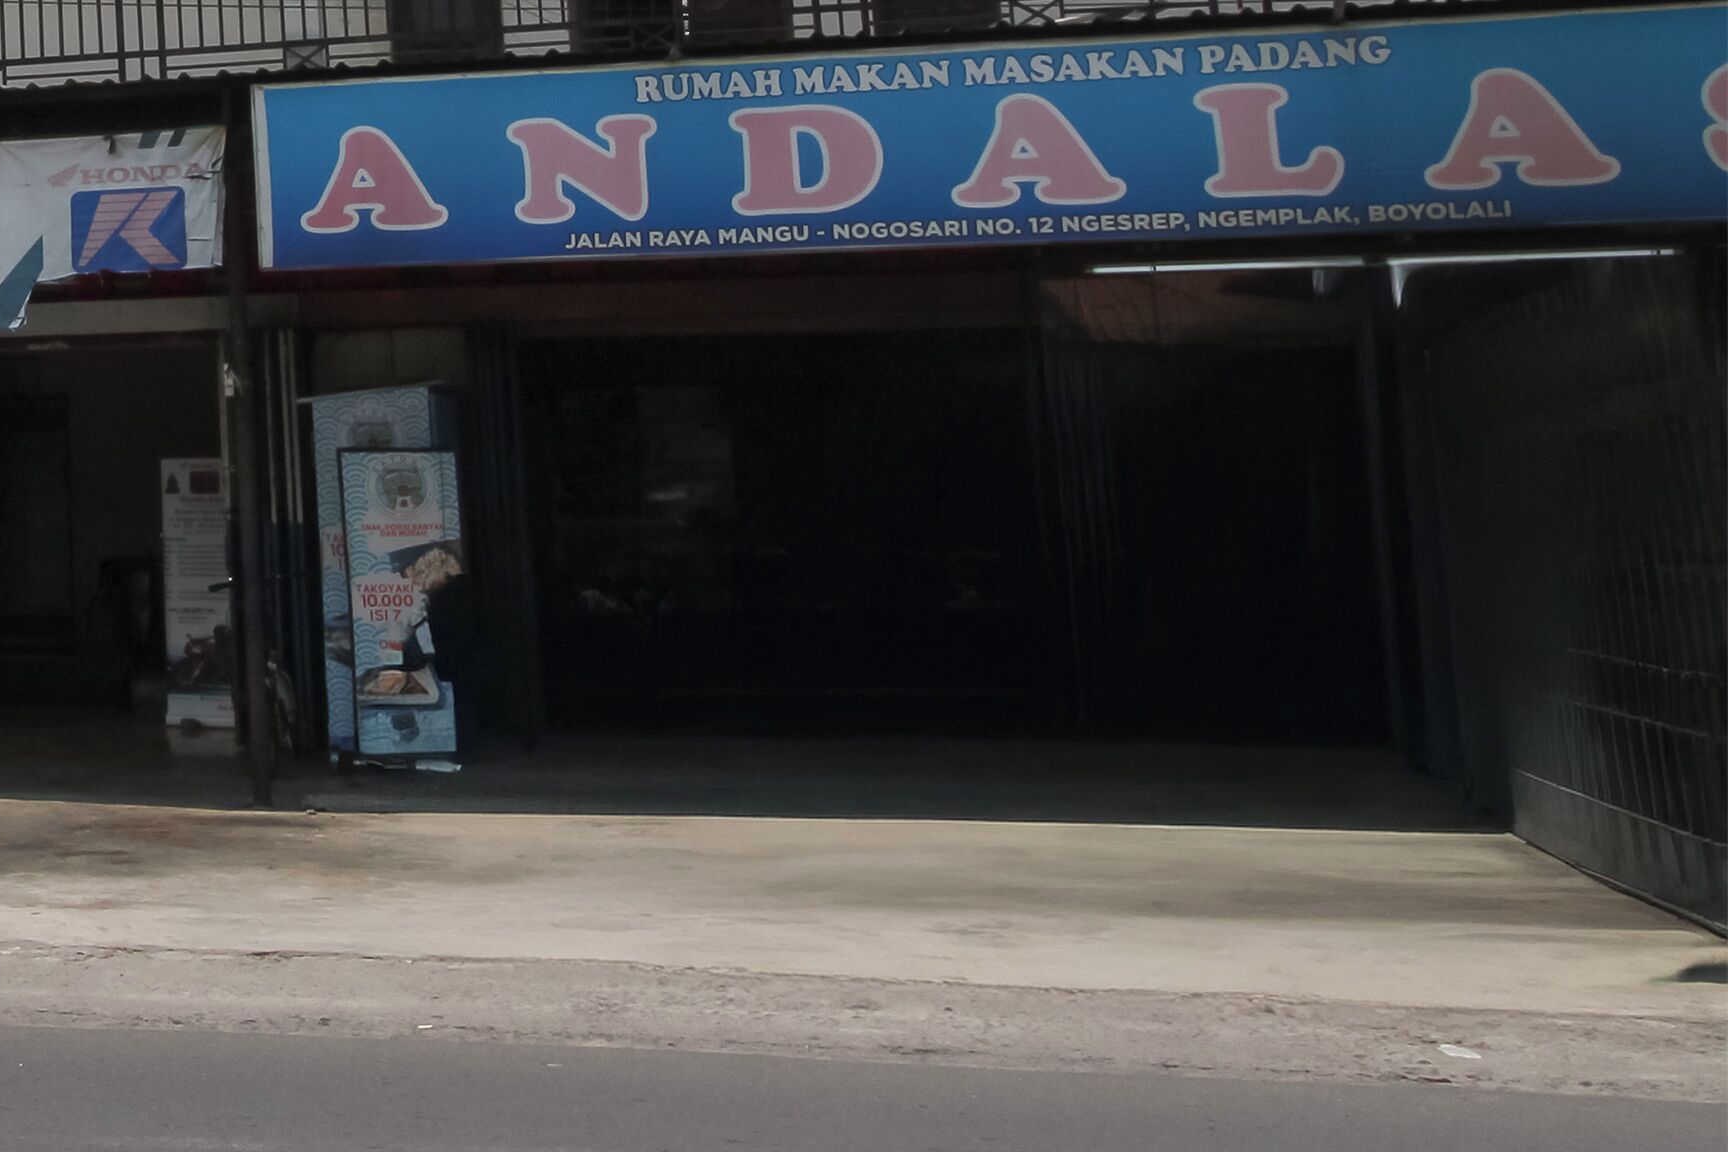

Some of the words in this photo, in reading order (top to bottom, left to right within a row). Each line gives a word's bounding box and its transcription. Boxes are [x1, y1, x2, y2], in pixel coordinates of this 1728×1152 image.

[634, 68, 784, 103] RUMAH
[792, 59, 950, 96] MAKAN
[962, 46, 1184, 86] MASAKAN
[1197, 35, 1392, 73] PADANG
[79, 161, 208, 185] HONDA
[565, 231, 642, 250] JALAN
[649, 229, 712, 248] RAYA
[718, 224, 809, 245] MANGU
[832, 219, 969, 240] NOGOSARI
[976, 217, 1021, 236] NO.
[1028, 216, 1053, 234] 12
[1061, 211, 1190, 234] NGESREP,
[1198, 204, 1360, 228] NGEMPLAK,
[1369, 199, 1512, 223] BOYOLALI
[356, 584, 414, 593] TAKOYAKI
[360, 594, 414, 608] 10.000
[370, 609, 389, 621] ISI
[392, 609, 401, 621] 7
